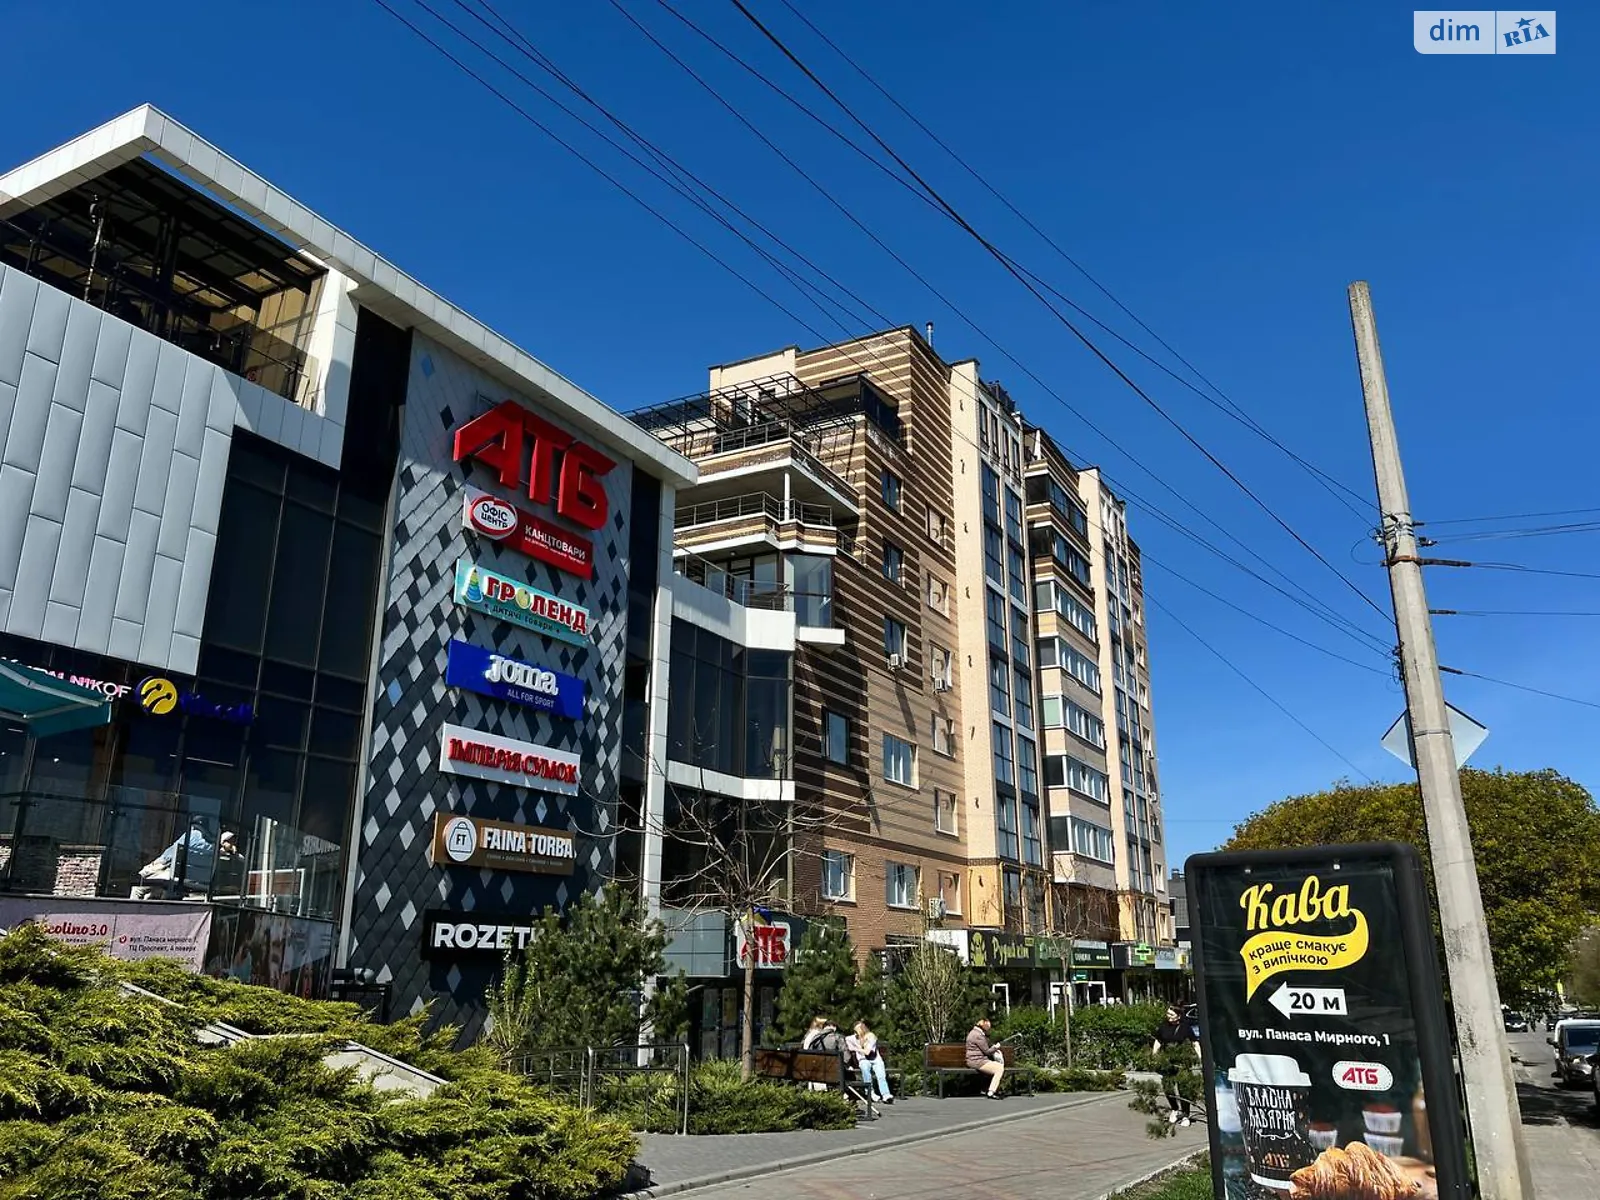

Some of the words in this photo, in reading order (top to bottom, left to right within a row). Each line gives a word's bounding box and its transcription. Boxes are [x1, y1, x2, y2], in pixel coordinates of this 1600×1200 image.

[453, 400, 617, 531] АТБ
[525, 525, 586, 560] КАНЦТОВАРИ
[507, 689, 520, 700] ALL
[520, 692, 534, 704] FOR
[534, 696, 555, 708] SPORT
[522, 755, 577, 784] СУМОК
[456, 834, 467, 846] FT
[481, 826, 527, 854] FAINA
[1240, 875, 1351, 931] Кава
[1249, 940, 1292, 961] краще
[1296, 940, 1347, 955] смакує
[1253, 965, 1261, 974] з
[1263, 952, 1328, 969] випічкою
[1290, 992, 1315, 1010] 20
[1238, 1029, 1263, 1041] вул.
[1265, 1028, 1312, 1042] Панаса
[1314, 1031, 1381, 1047] Мирного,
[1383, 1034, 1390, 1045] 1
